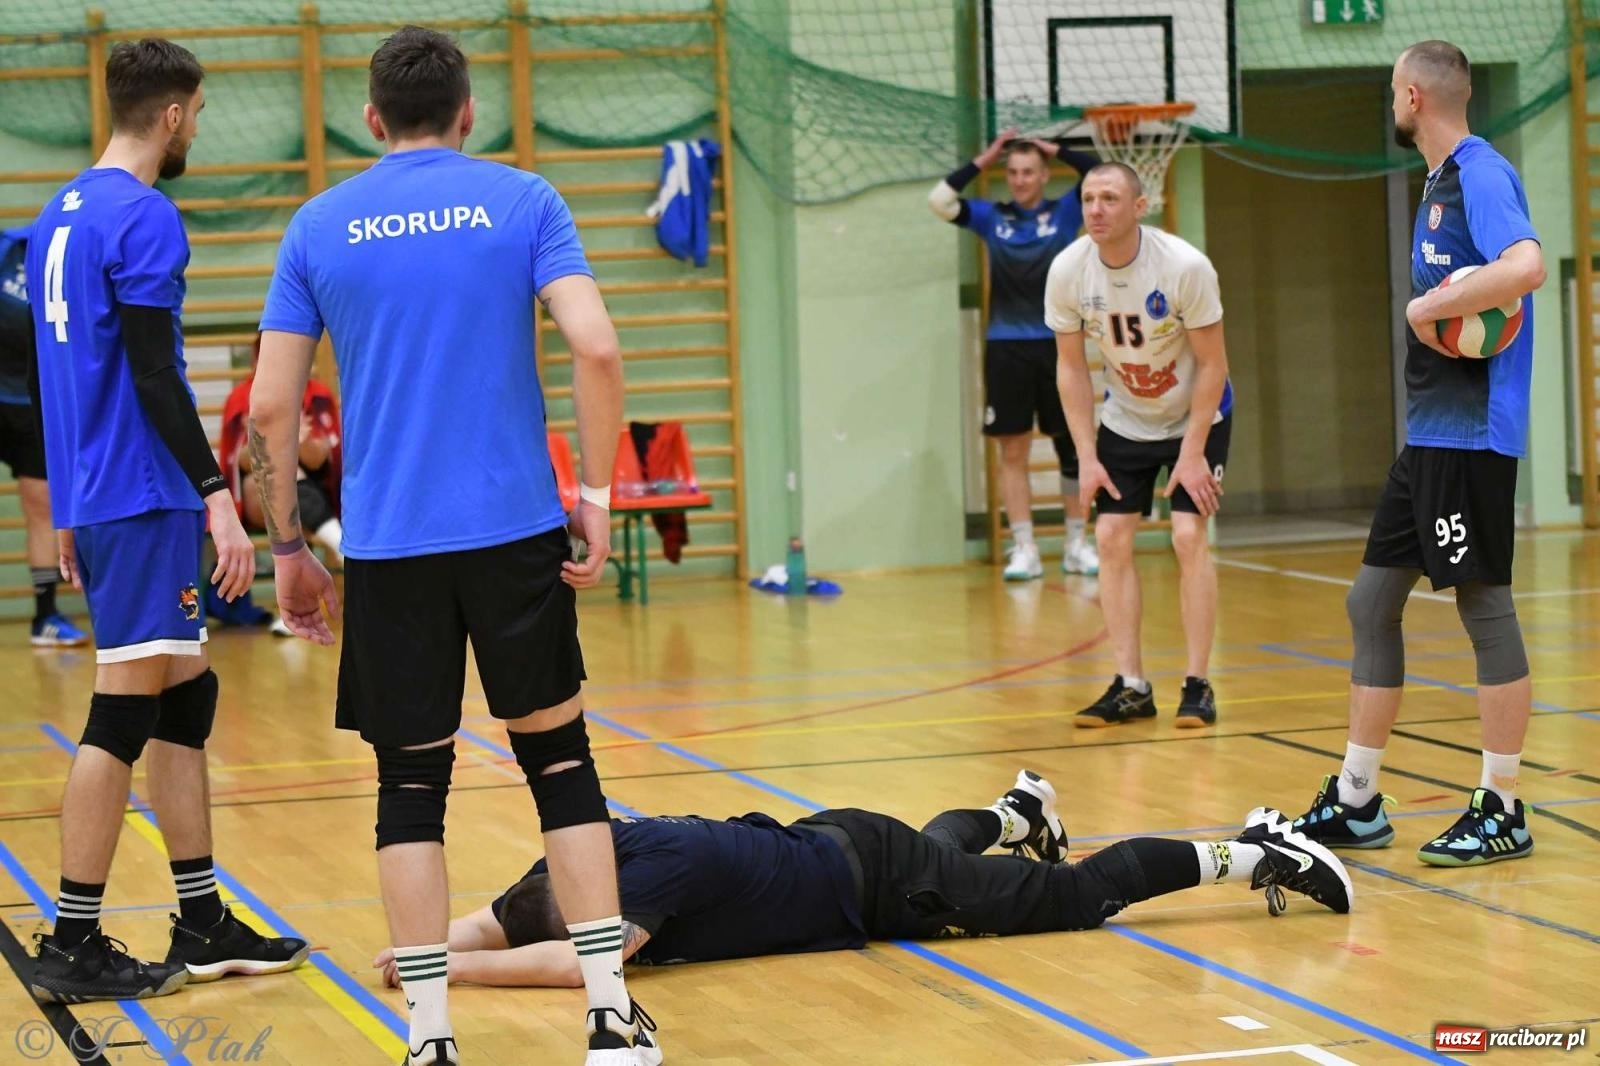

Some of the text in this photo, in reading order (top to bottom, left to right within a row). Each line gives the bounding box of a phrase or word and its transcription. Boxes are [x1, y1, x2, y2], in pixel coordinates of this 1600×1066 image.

[347, 205, 493, 244] SKORUPA
[44, 226, 72, 342] 4
[1109, 313, 1146, 349] 15
[1435, 512, 1467, 547] 95
